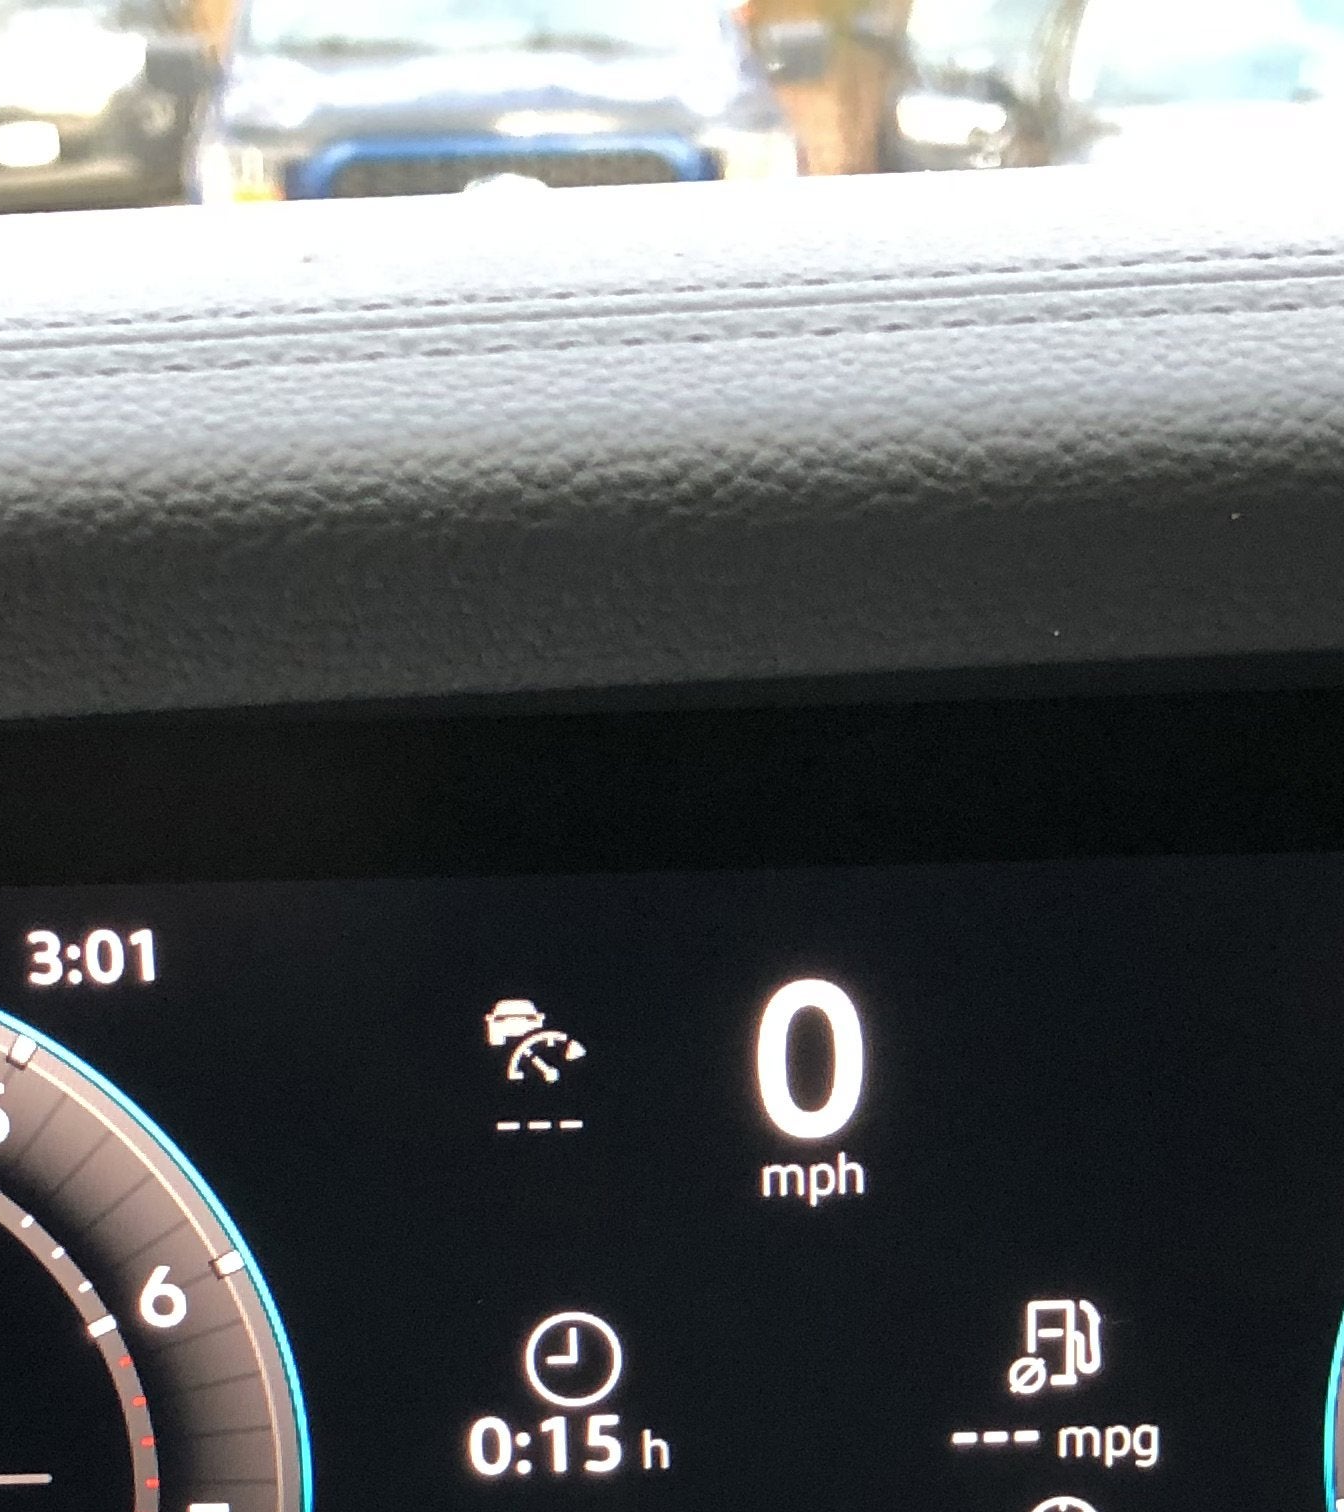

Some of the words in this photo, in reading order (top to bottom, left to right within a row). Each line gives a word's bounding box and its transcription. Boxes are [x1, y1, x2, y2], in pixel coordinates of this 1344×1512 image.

[25, 928, 156, 986] 3:01
[755, 978, 865, 1141] 0
[760, 1151, 865, 1207] mph
[138, 1264, 189, 1329] 6
[466, 1414, 624, 1477] 0:15
[641, 1428, 670, 1470] h
[1058, 1423, 1160, 1468] mpg
